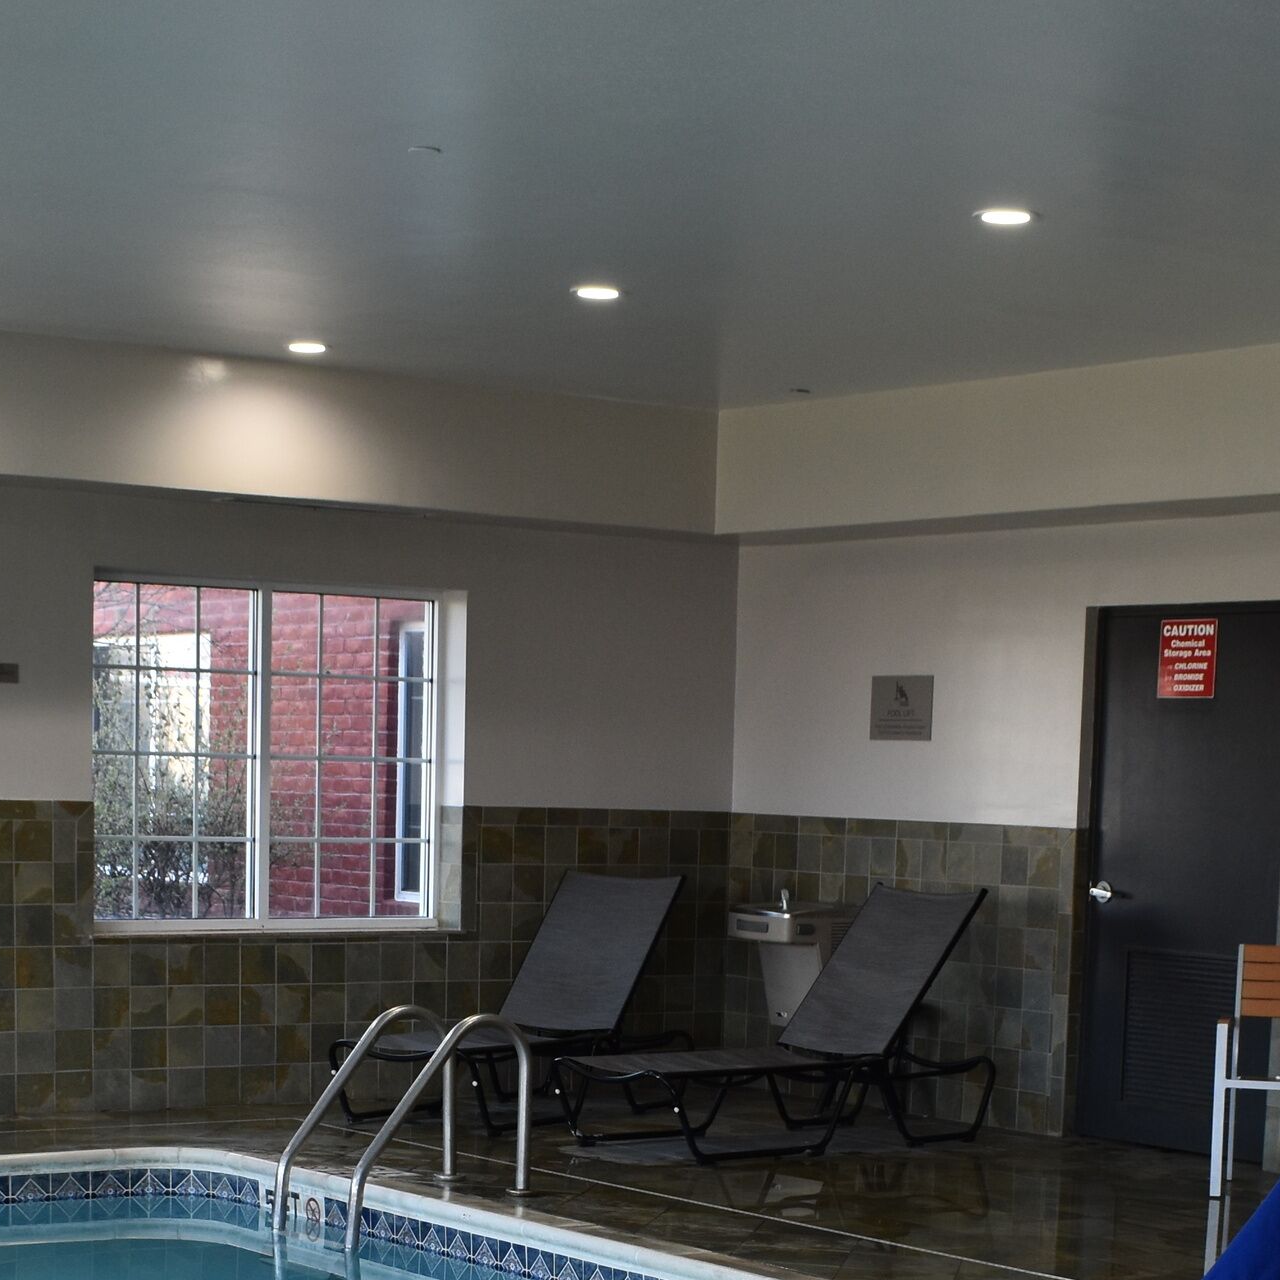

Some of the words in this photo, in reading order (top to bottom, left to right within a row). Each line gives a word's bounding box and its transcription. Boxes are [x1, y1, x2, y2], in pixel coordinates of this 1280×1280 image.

[1163, 624, 1215, 636] CAUTION
[1171, 639, 1205, 648] Chemical
[1163, 649, 1192, 658] Storage
[1194, 649, 1211, 657] Area
[1174, 662, 1208, 670] CHLORINE
